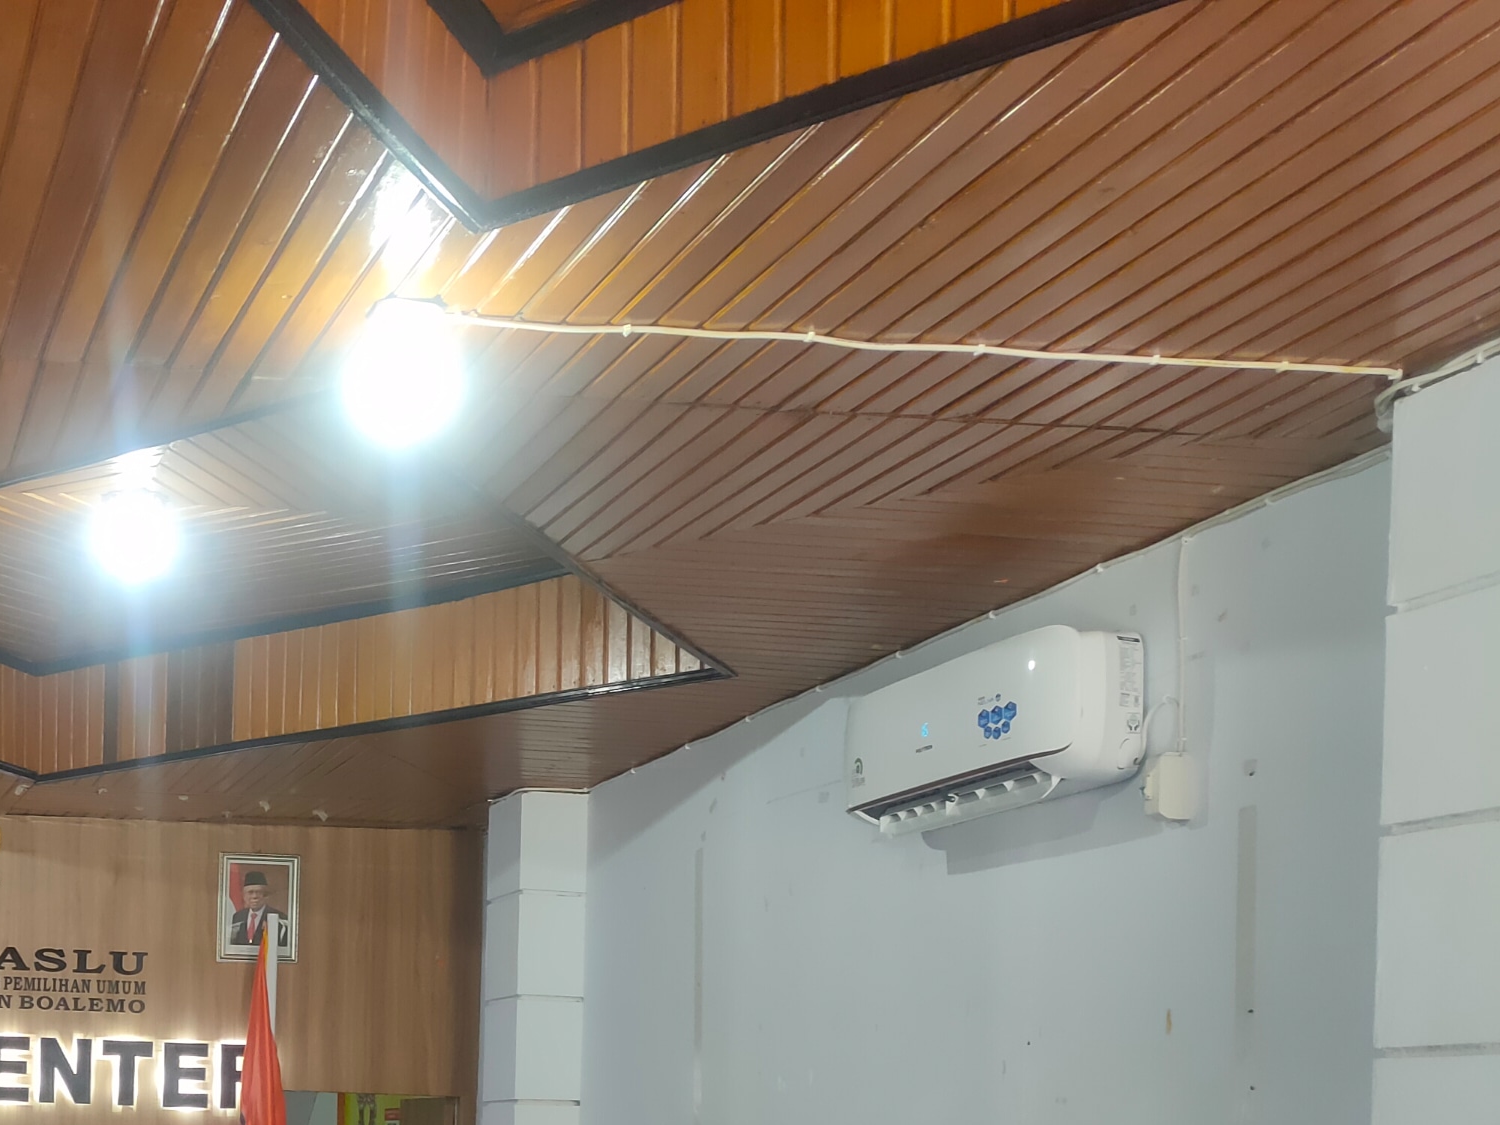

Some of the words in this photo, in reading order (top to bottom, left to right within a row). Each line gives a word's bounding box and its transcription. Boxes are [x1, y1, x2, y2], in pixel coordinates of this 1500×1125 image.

[3, 975, 91, 994] PEMILIHAN
[96, 979, 147, 996] UMUM
[18, 993, 146, 1014] BOALEMO
